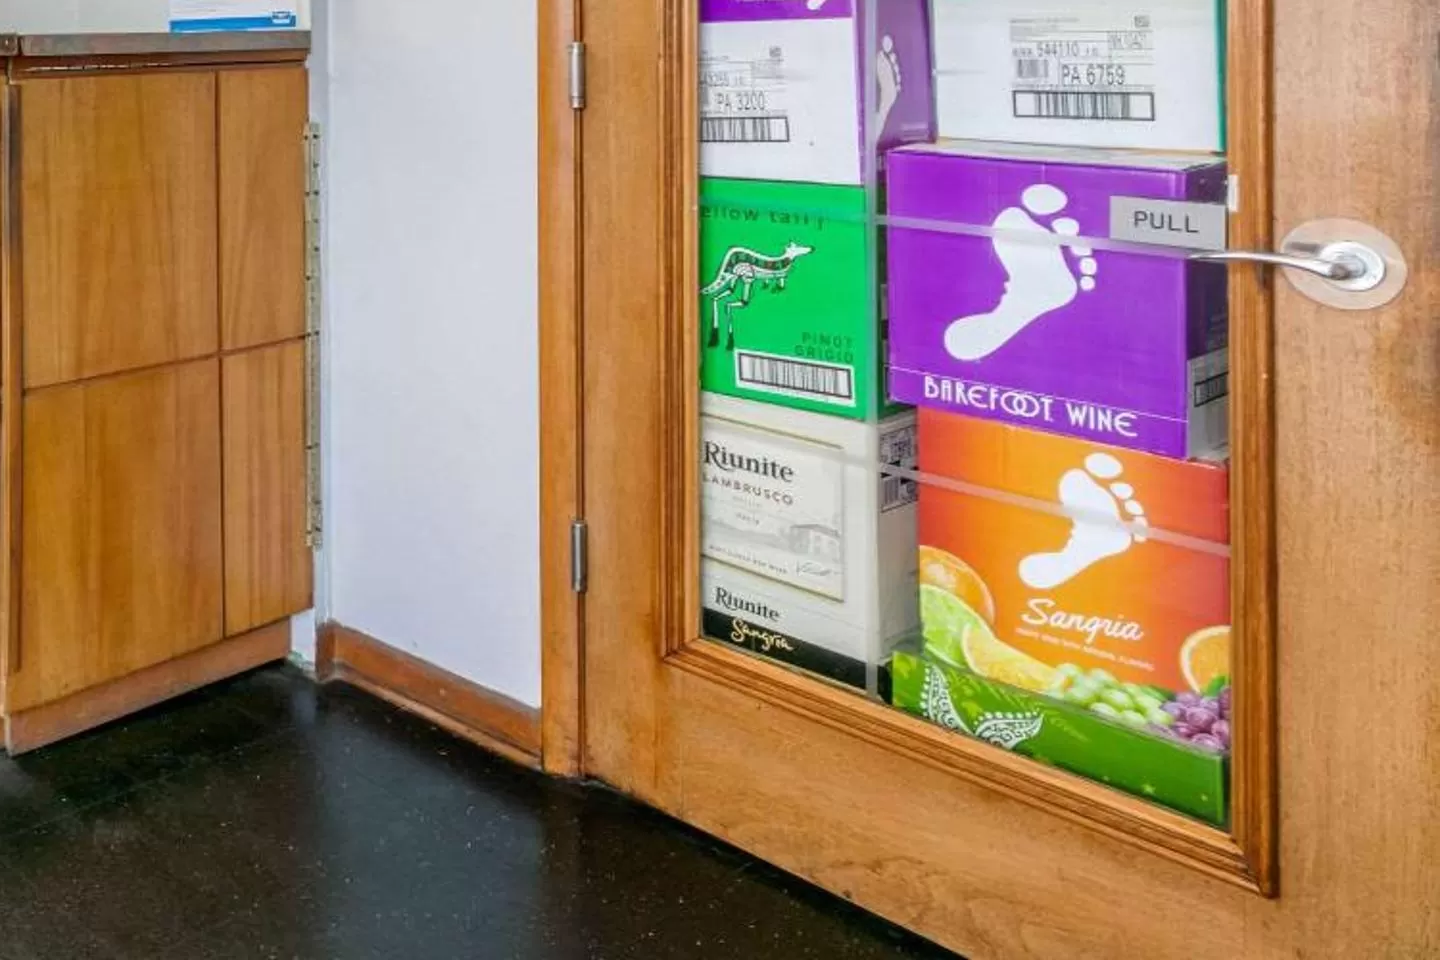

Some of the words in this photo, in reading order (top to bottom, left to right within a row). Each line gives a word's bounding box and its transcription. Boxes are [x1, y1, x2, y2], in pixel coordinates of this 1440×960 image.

[700, 206, 759, 221] ellow
[1134, 210, 1200, 234] PULL
[794, 344, 855, 364] GRIGIO
[801, 331, 854, 348] PINOT
[924, 376, 1054, 422] BAREFOOT
[1066, 403, 1139, 437] WINE
[703, 440, 795, 483] Riunite
[702, 472, 794, 507] LAMBRUSCO
[715, 586, 781, 622] Riunite
[1021, 598, 1144, 643] Sangria
